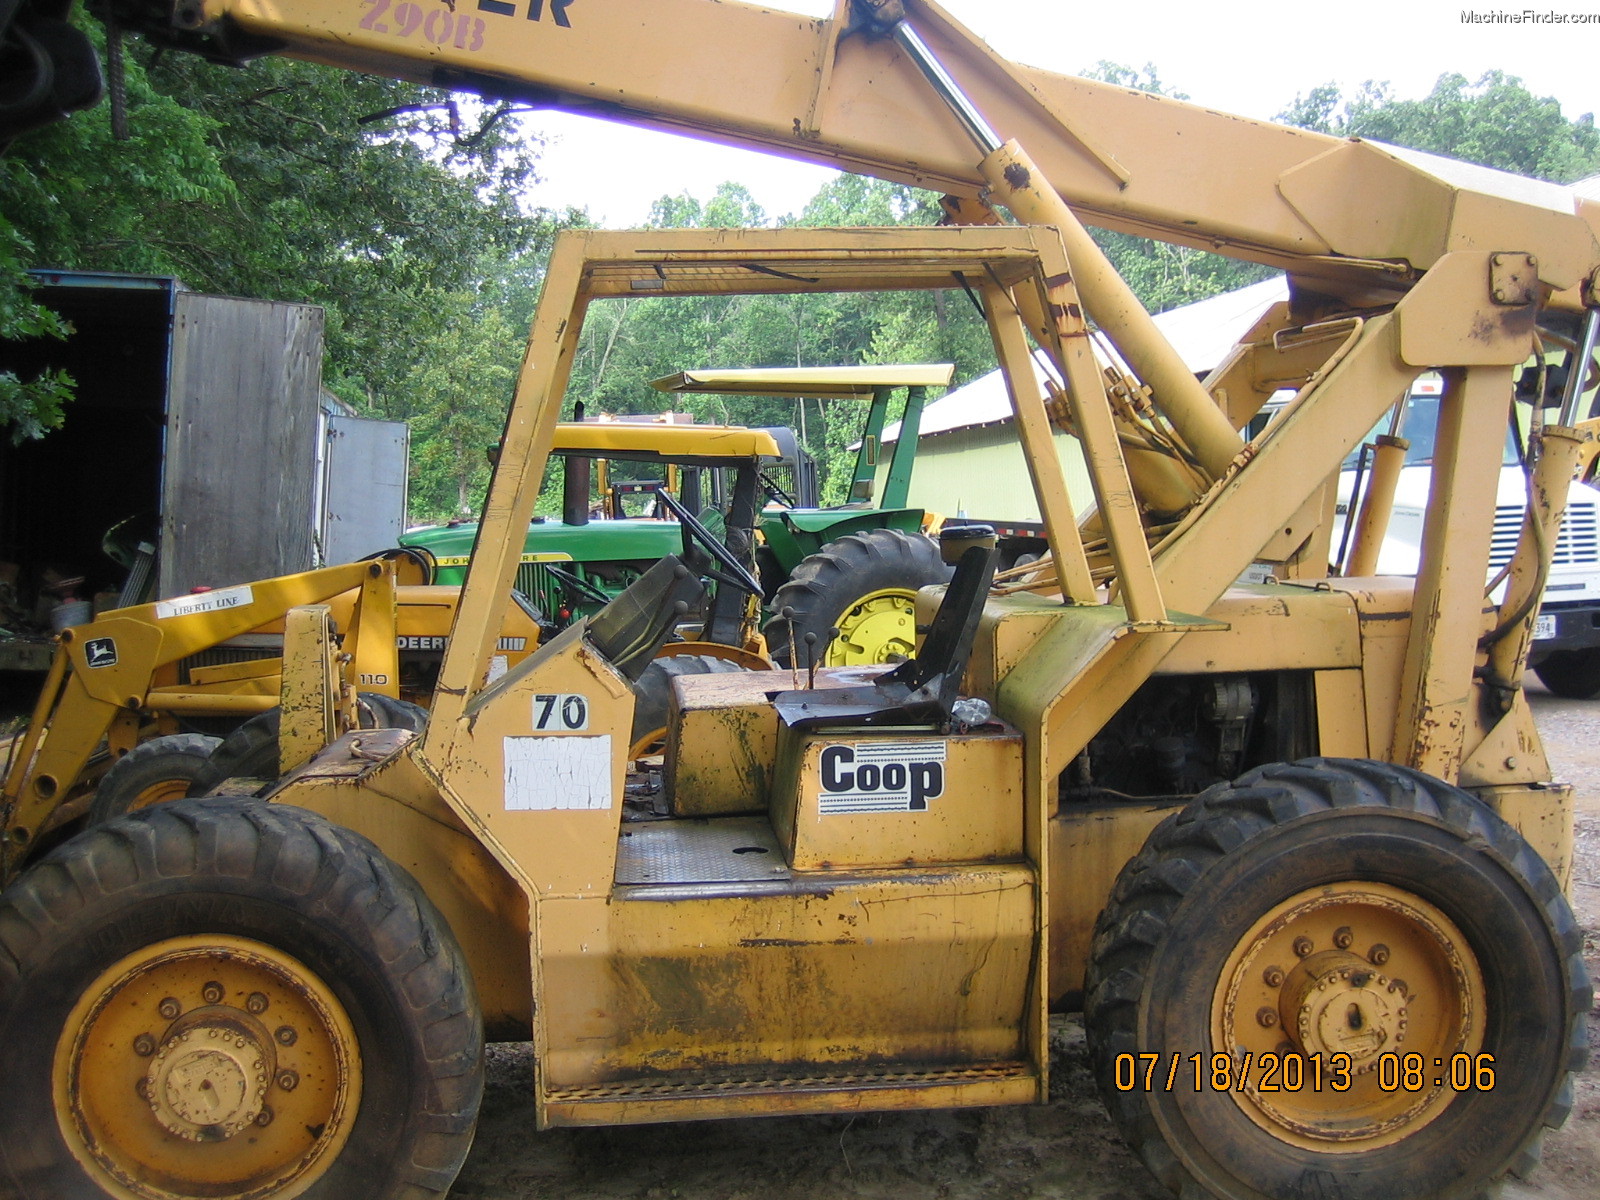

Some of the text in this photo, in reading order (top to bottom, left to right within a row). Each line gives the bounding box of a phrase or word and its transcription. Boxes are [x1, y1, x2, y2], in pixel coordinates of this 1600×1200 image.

[359, 0, 486, 51] 290B
[173, 596, 239, 616] LIBERTY LINE
[396, 636, 450, 649] DEER
[360, 674, 388, 685] 110
[533, 694, 589, 730] 70
[821, 746, 944, 810] Coop
